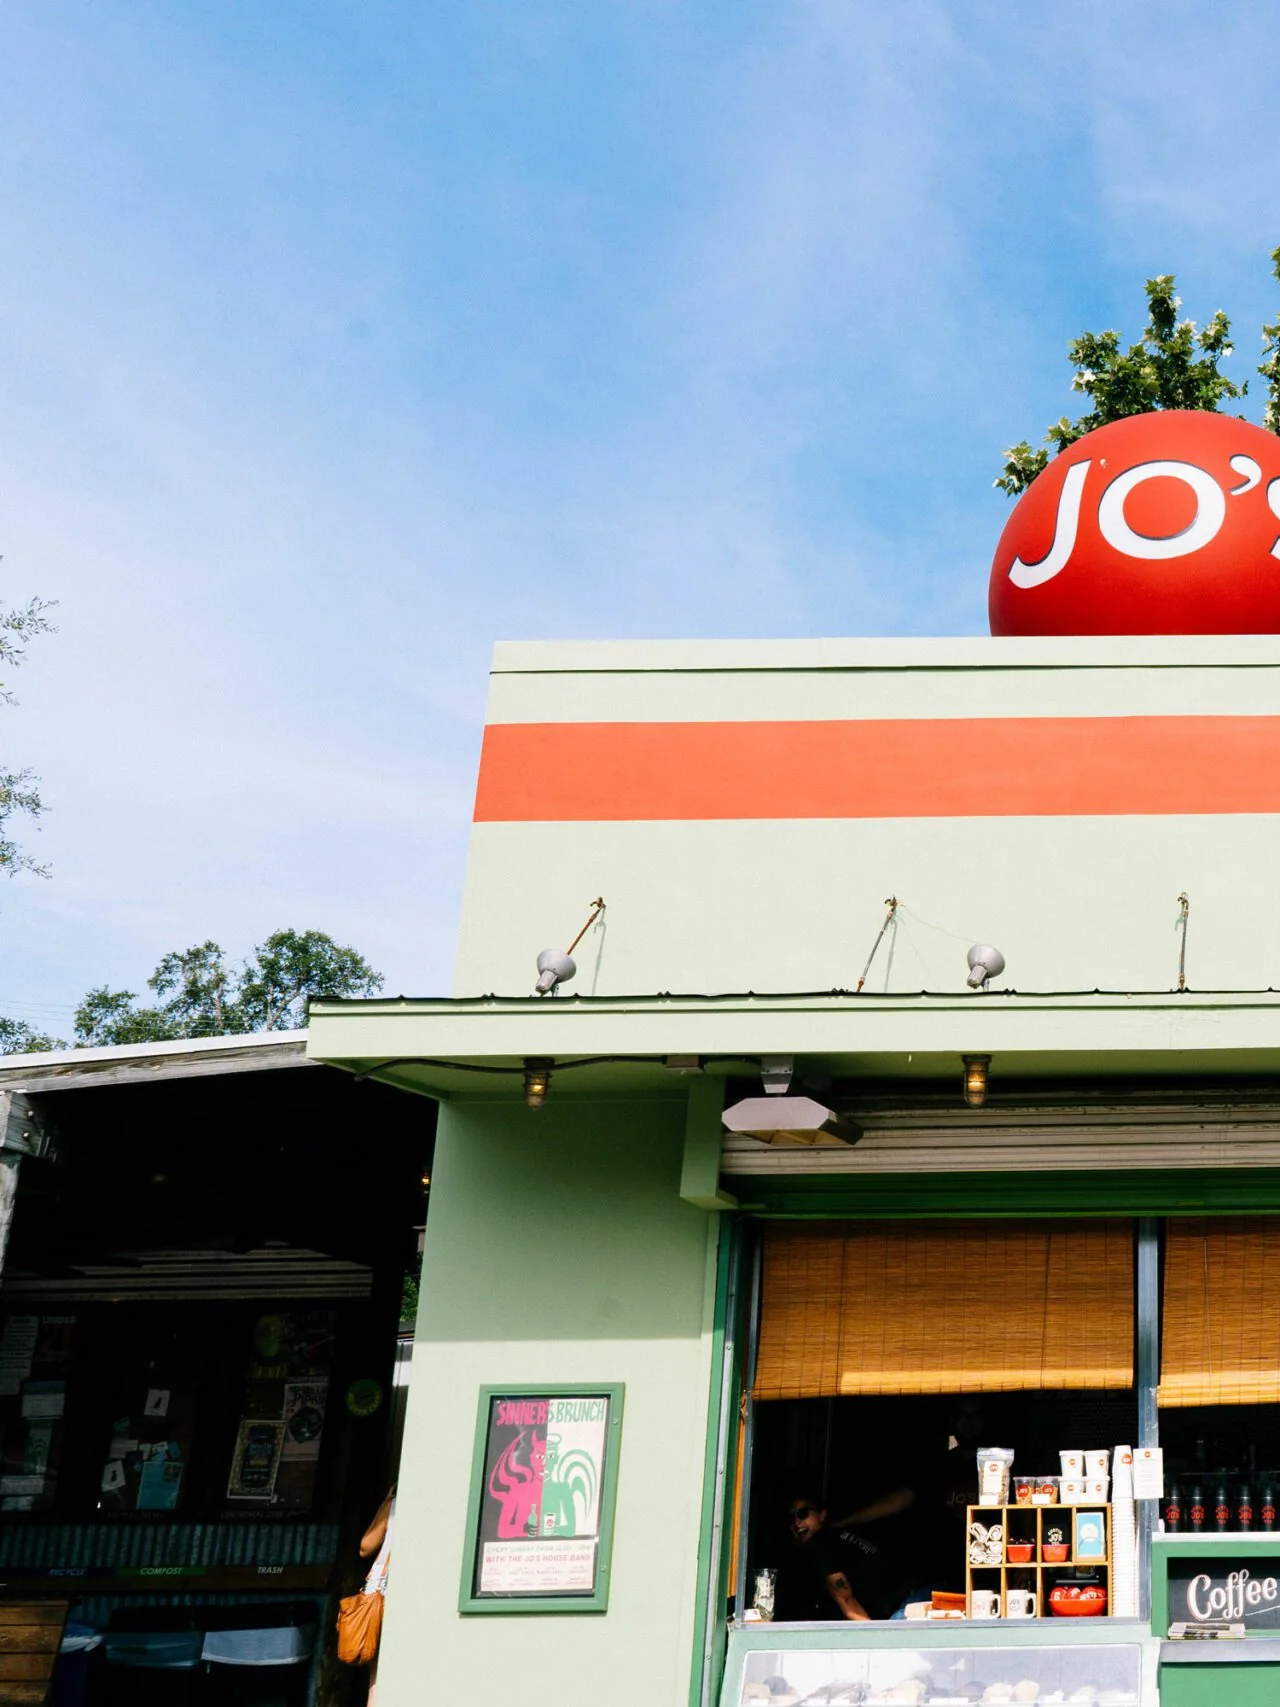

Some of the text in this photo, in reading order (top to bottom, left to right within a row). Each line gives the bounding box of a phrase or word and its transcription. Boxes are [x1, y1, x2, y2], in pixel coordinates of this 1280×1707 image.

[556, 1401, 605, 1423] BRUNCH
[543, 1553, 568, 1561] HOUSE
[140, 1567, 183, 1576] COMPOST
[257, 1566, 284, 1575] TRASH
[1187, 1569, 1278, 1621] Coffee
